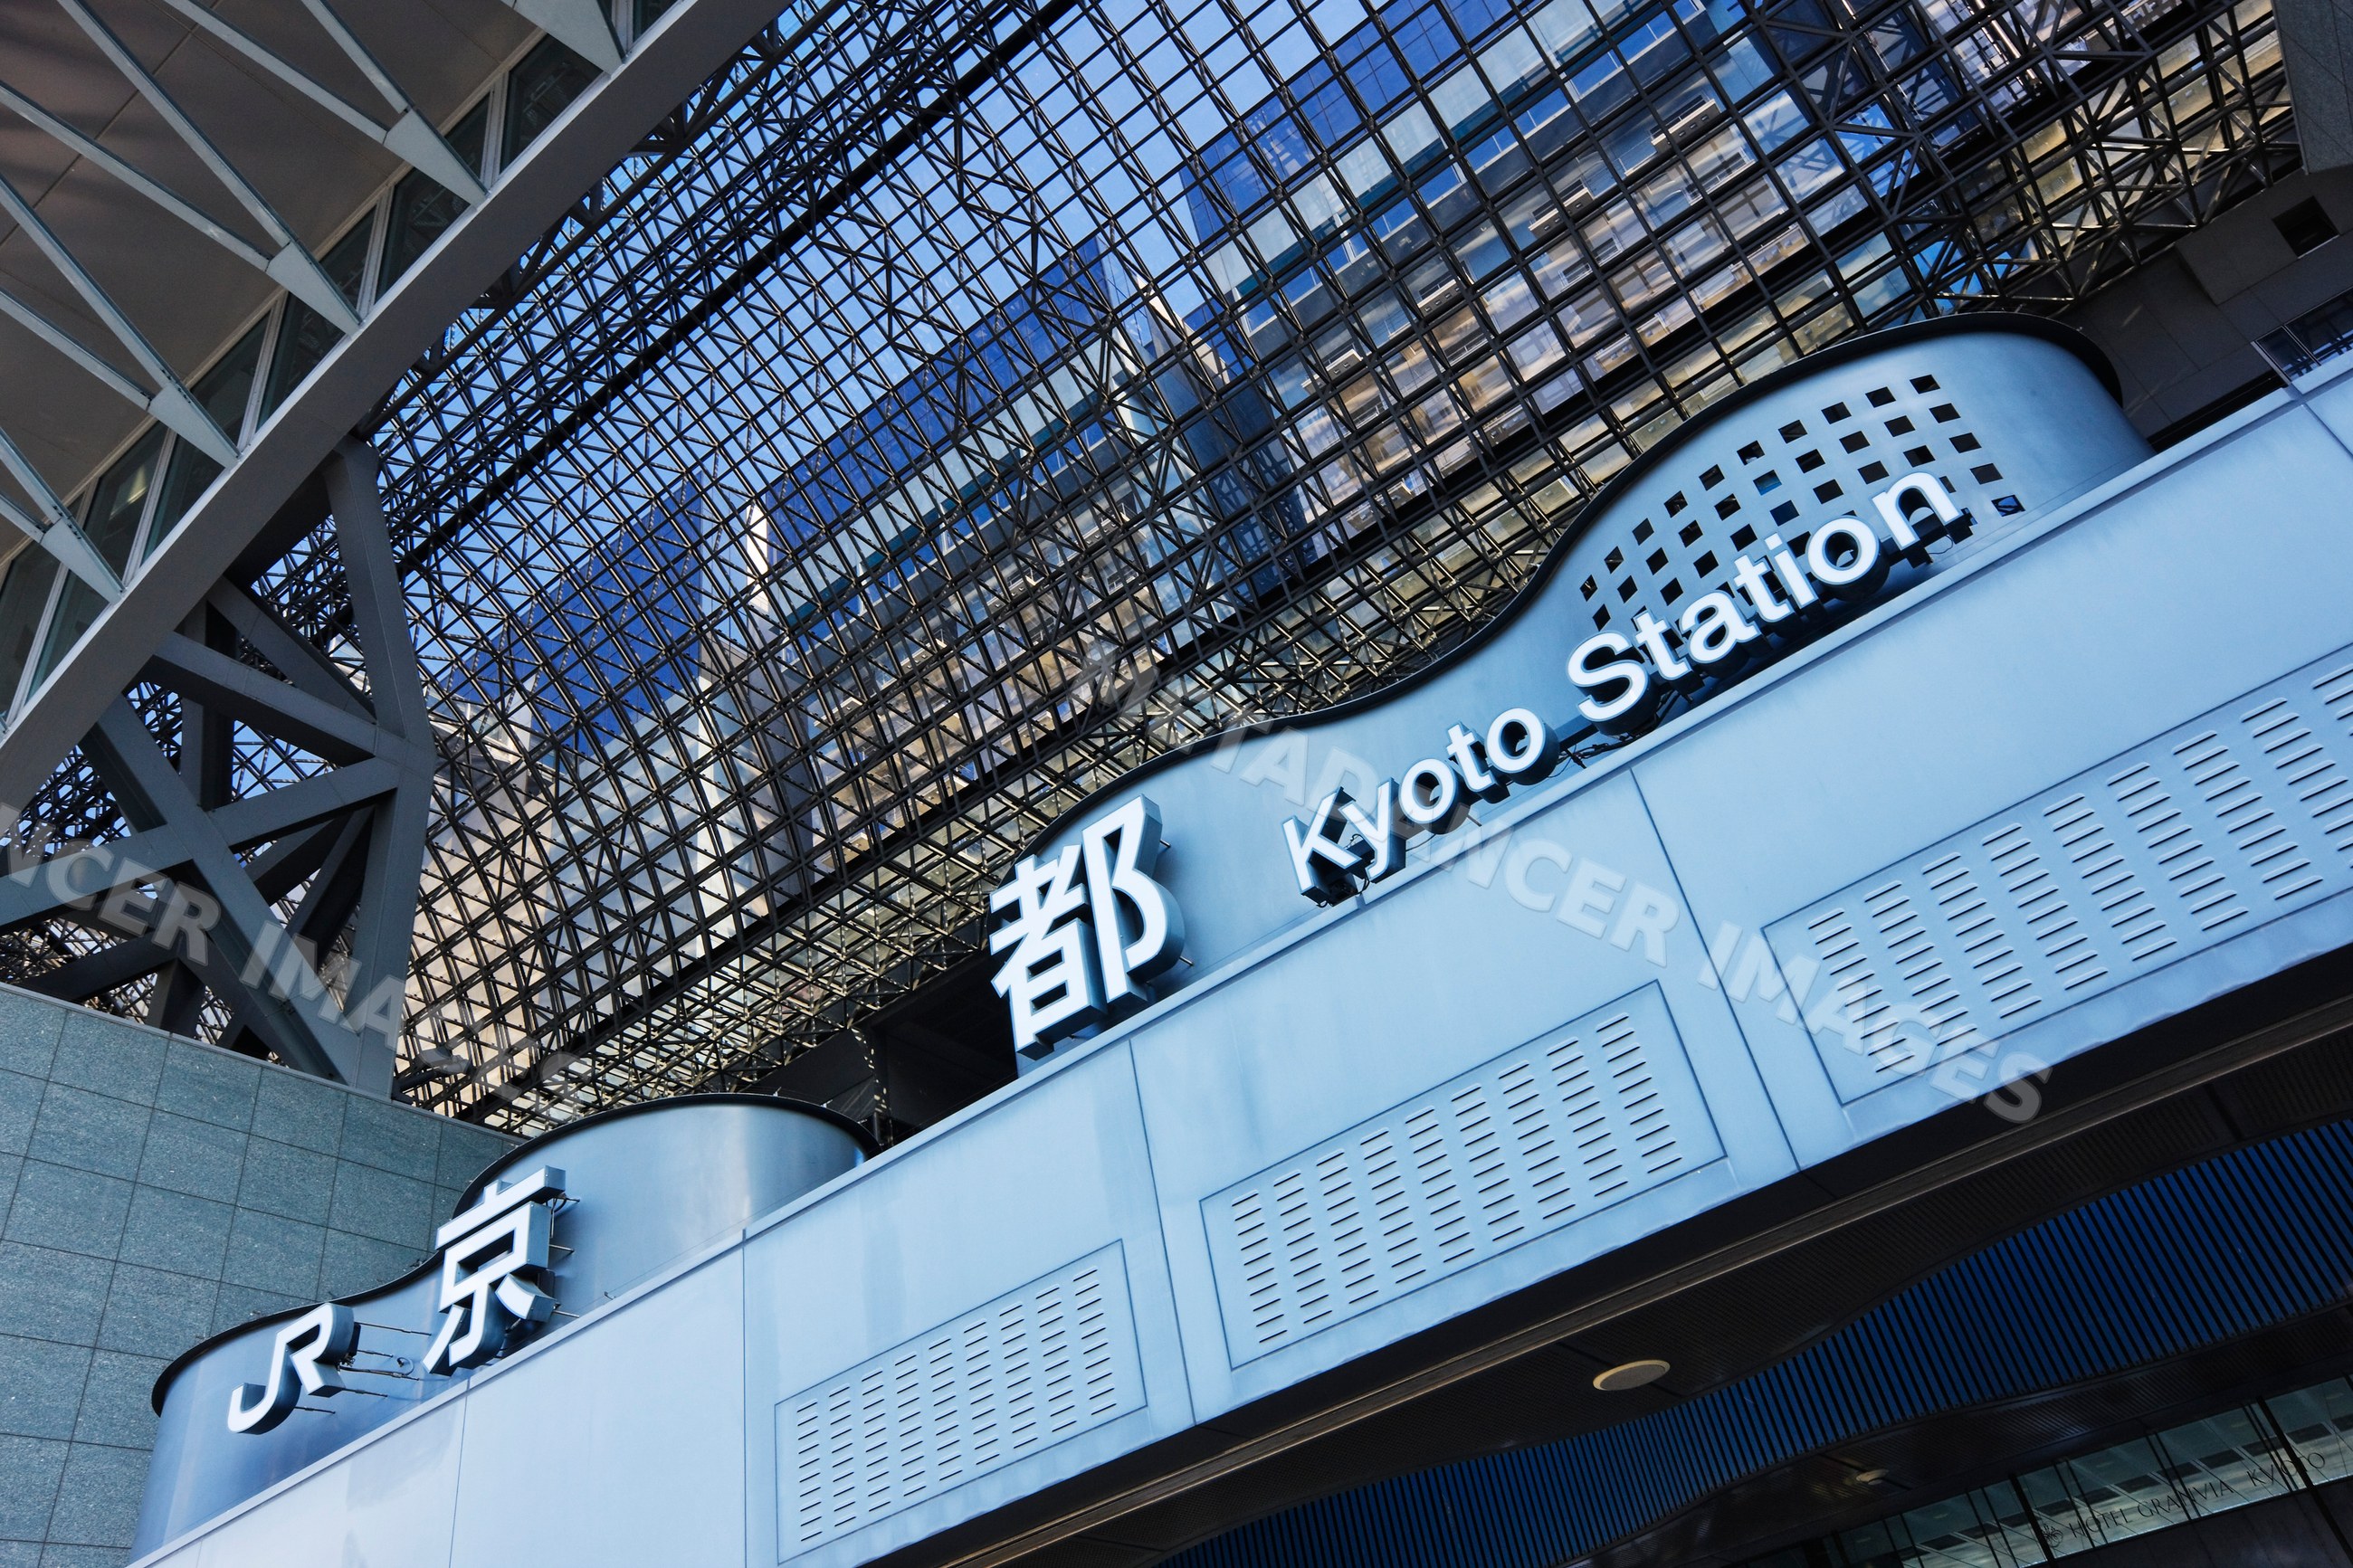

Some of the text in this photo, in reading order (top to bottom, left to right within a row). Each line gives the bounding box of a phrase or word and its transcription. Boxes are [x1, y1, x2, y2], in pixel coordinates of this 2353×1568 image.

[228, 1303, 342, 1432] JR
[1281, 707, 1548, 894] Kyoto
[1566, 470, 1961, 722] Station
[2069, 1507, 2133, 1538] HOTEL
[2138, 1479, 2234, 1518] GRANVIA
